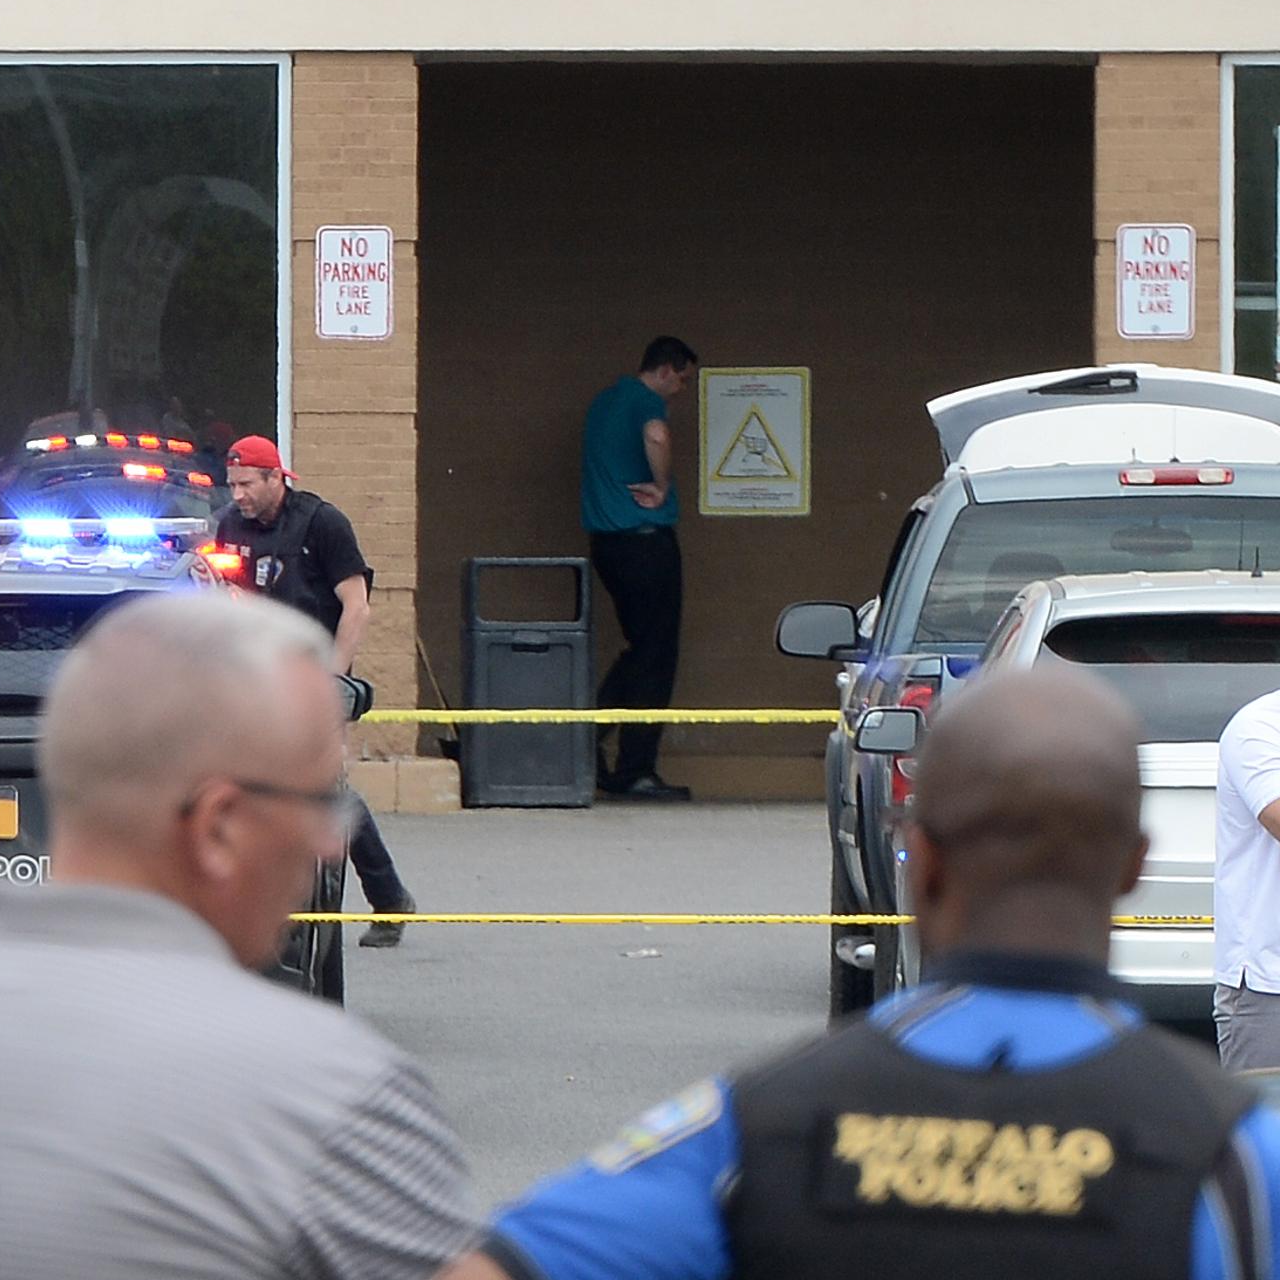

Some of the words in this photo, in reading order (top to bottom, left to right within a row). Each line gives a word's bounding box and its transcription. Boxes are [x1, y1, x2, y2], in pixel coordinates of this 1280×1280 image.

[340, 237, 368, 257] NO
[1143, 235, 1170, 256] NO
[322, 262, 387, 282] PARKING
[1123, 260, 1189, 280] PARKING
[339, 285, 369, 299] FIRE
[1140, 283, 1170, 297] FIRE
[336, 301, 371, 316] LANE
[1138, 300, 1172, 314] LANE
[832, 1113, 1114, 1178] BUFFALO
[856, 1154, 1083, 1215] POLICE
